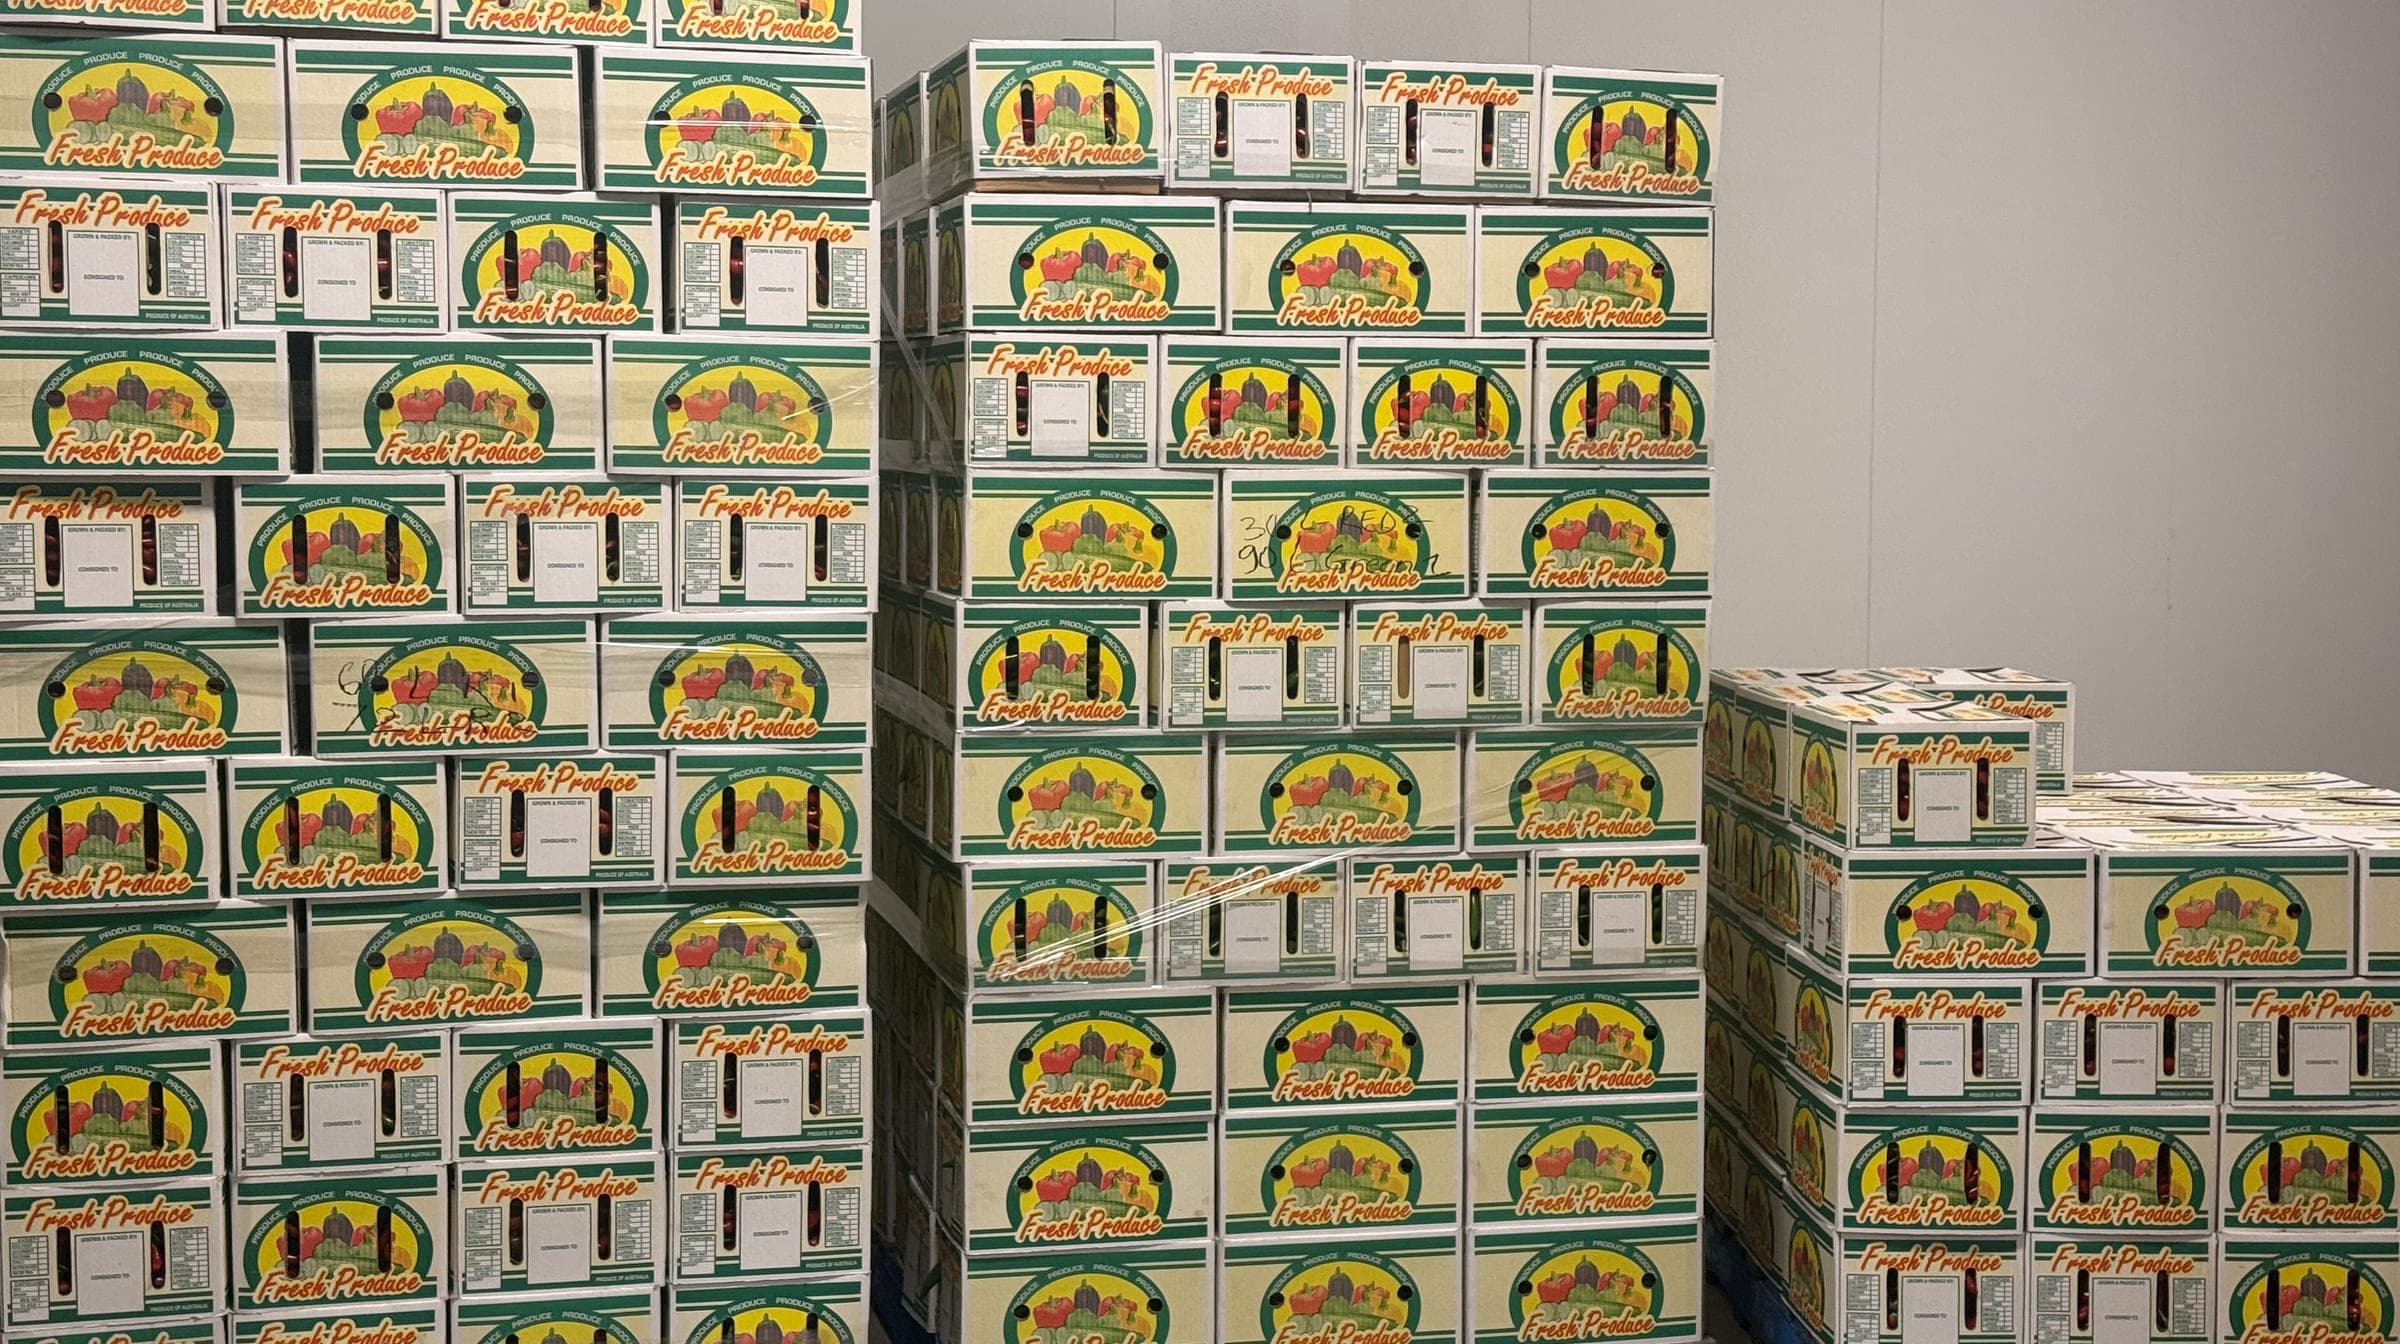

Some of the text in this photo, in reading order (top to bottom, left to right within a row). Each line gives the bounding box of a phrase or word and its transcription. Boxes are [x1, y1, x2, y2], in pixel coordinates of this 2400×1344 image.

[84, 52, 184, 70] PRODUCE PRODUCE
[693, 74, 782, 92] PRODUCE PRODUCE
[1190, 66, 1332, 95] Fresh Produce
[1381, 75, 1518, 105] Fresh Produce
[1563, 91, 1704, 141] PRODUCE PRODUCE PRODUCE PRODUCE
[51, 133, 222, 166] Fresh Produce
[660, 152, 816, 183] Fresh Produce
[1568, 161, 1698, 192] Fresh Produce
[15, 193, 189, 227] Fresh Produce
[252, 200, 419, 233] Fresh Produce
[1054, 217, 1137, 232] PRODUCE PRODUCE
[471, 213, 640, 265] PRODUCE PRODUCE PRODUCE PRODUCE
[1559, 227, 1636, 242] PRODUCE PRODUCE
[481, 292, 637, 322] Fresh Produce
[1024, 291, 1168, 320] Fresh Produce
[1529, 298, 1664, 326] Fresh Produce
[85, 350, 184, 367] PRODUCE PRODUCE
[701, 355, 789, 372] PRODUCE PRODUCE
[988, 347, 1132, 376] Fresh Produce
[49, 431, 222, 463] Fresh Produce
[667, 432, 820, 462] Fresh Produce
[1377, 431, 1511, 458] Fresh Produce
[486, 488, 645, 517] Fresh Produce
[1564, 488, 1639, 503] PRODUCE PRODUCE
[258, 496, 433, 546] PRODUCE PRODUCE PRODUCE PRODUCE
[1337, 505, 1397, 534] RED
[1281, 562, 1420, 590] Fresh Produce
[1533, 559, 1665, 586] Fresh Produce
[268, 575, 430, 606] Fresh Produce
[1013, 619, 1049, 633] PRODUCE
[984, 693, 1124, 720] Fresh Produce
[55, 720, 226, 751] Fresh Produce
[1043, 747, 1125, 761] PRODUCE PRODUCE
[1936, 738, 2013, 764] Produce
[690, 766, 850, 815] PRODUCE PRODUCE PRODUCE PRODUCE
[1012, 820, 1154, 847] Fresh Produce
[698, 842, 846, 871] Fresh Produce
[1554, 861, 1685, 888] Fresh Produce
[1929, 870, 2010, 884] PRODUCE PRODUCE
[1898, 940, 2039, 967] Fresh Produce
[2158, 938, 2300, 965] Fresh Produce
[1552, 993, 1627, 1007] PRODUCE PRODUCE
[1866, 992, 2006, 1019] Fresh Produce
[66, 1001, 234, 1034] Fresh Produce
[696, 1026, 847, 1056] Fresh Produce
[1521, 1062, 1654, 1090] Fresh Produce
[25, 1198, 192, 1232] Fresh Produce
[2055, 1196, 2194, 1223] Fresh Produce
[2245, 1196, 2383, 1222] Fresh Produce
[1020, 1209, 1162, 1240] Fresh Produce
[261, 1267, 420, 1300] Fresh Produce
